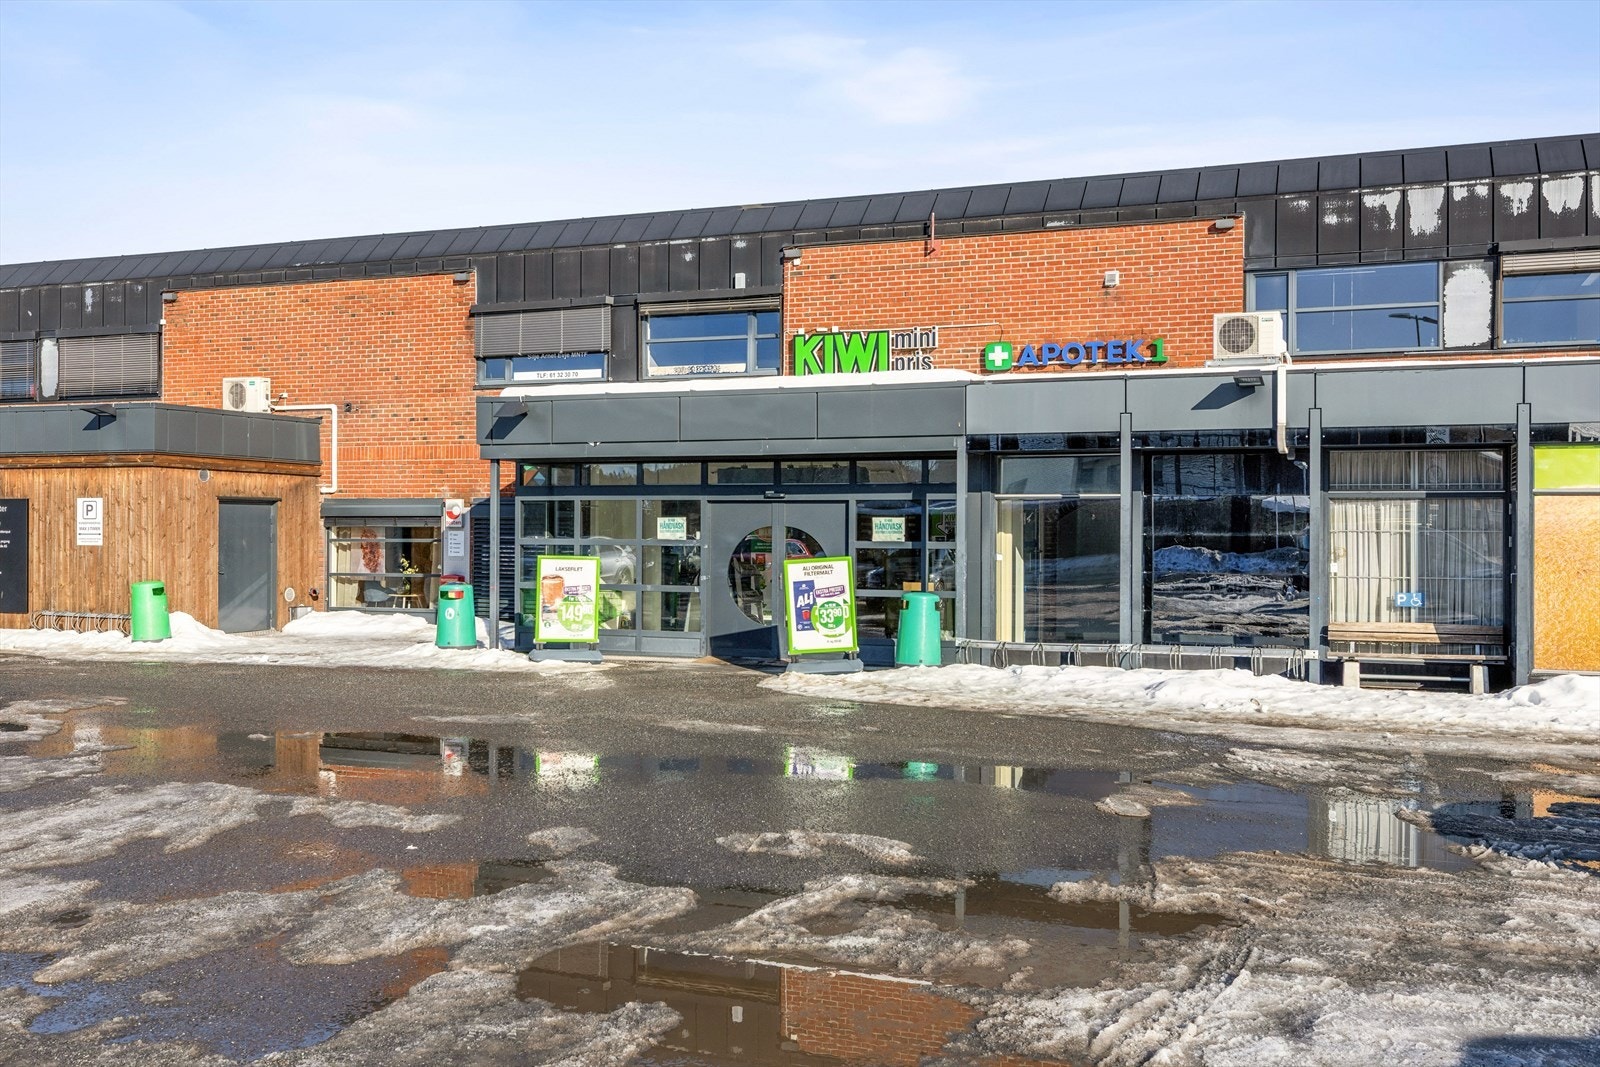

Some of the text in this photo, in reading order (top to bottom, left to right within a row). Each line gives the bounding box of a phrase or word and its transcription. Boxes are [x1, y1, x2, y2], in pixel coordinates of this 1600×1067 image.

[894, 326, 937, 349] mini
[793, 330, 891, 376] KIWI
[894, 351, 933, 371] pris
[1017, 338, 1169, 367] APOTEK 1
[86, 504, 94, 516] P
[874, 521, 904, 531] HÅNDVASK
[1397, 594, 1407, 606] P
